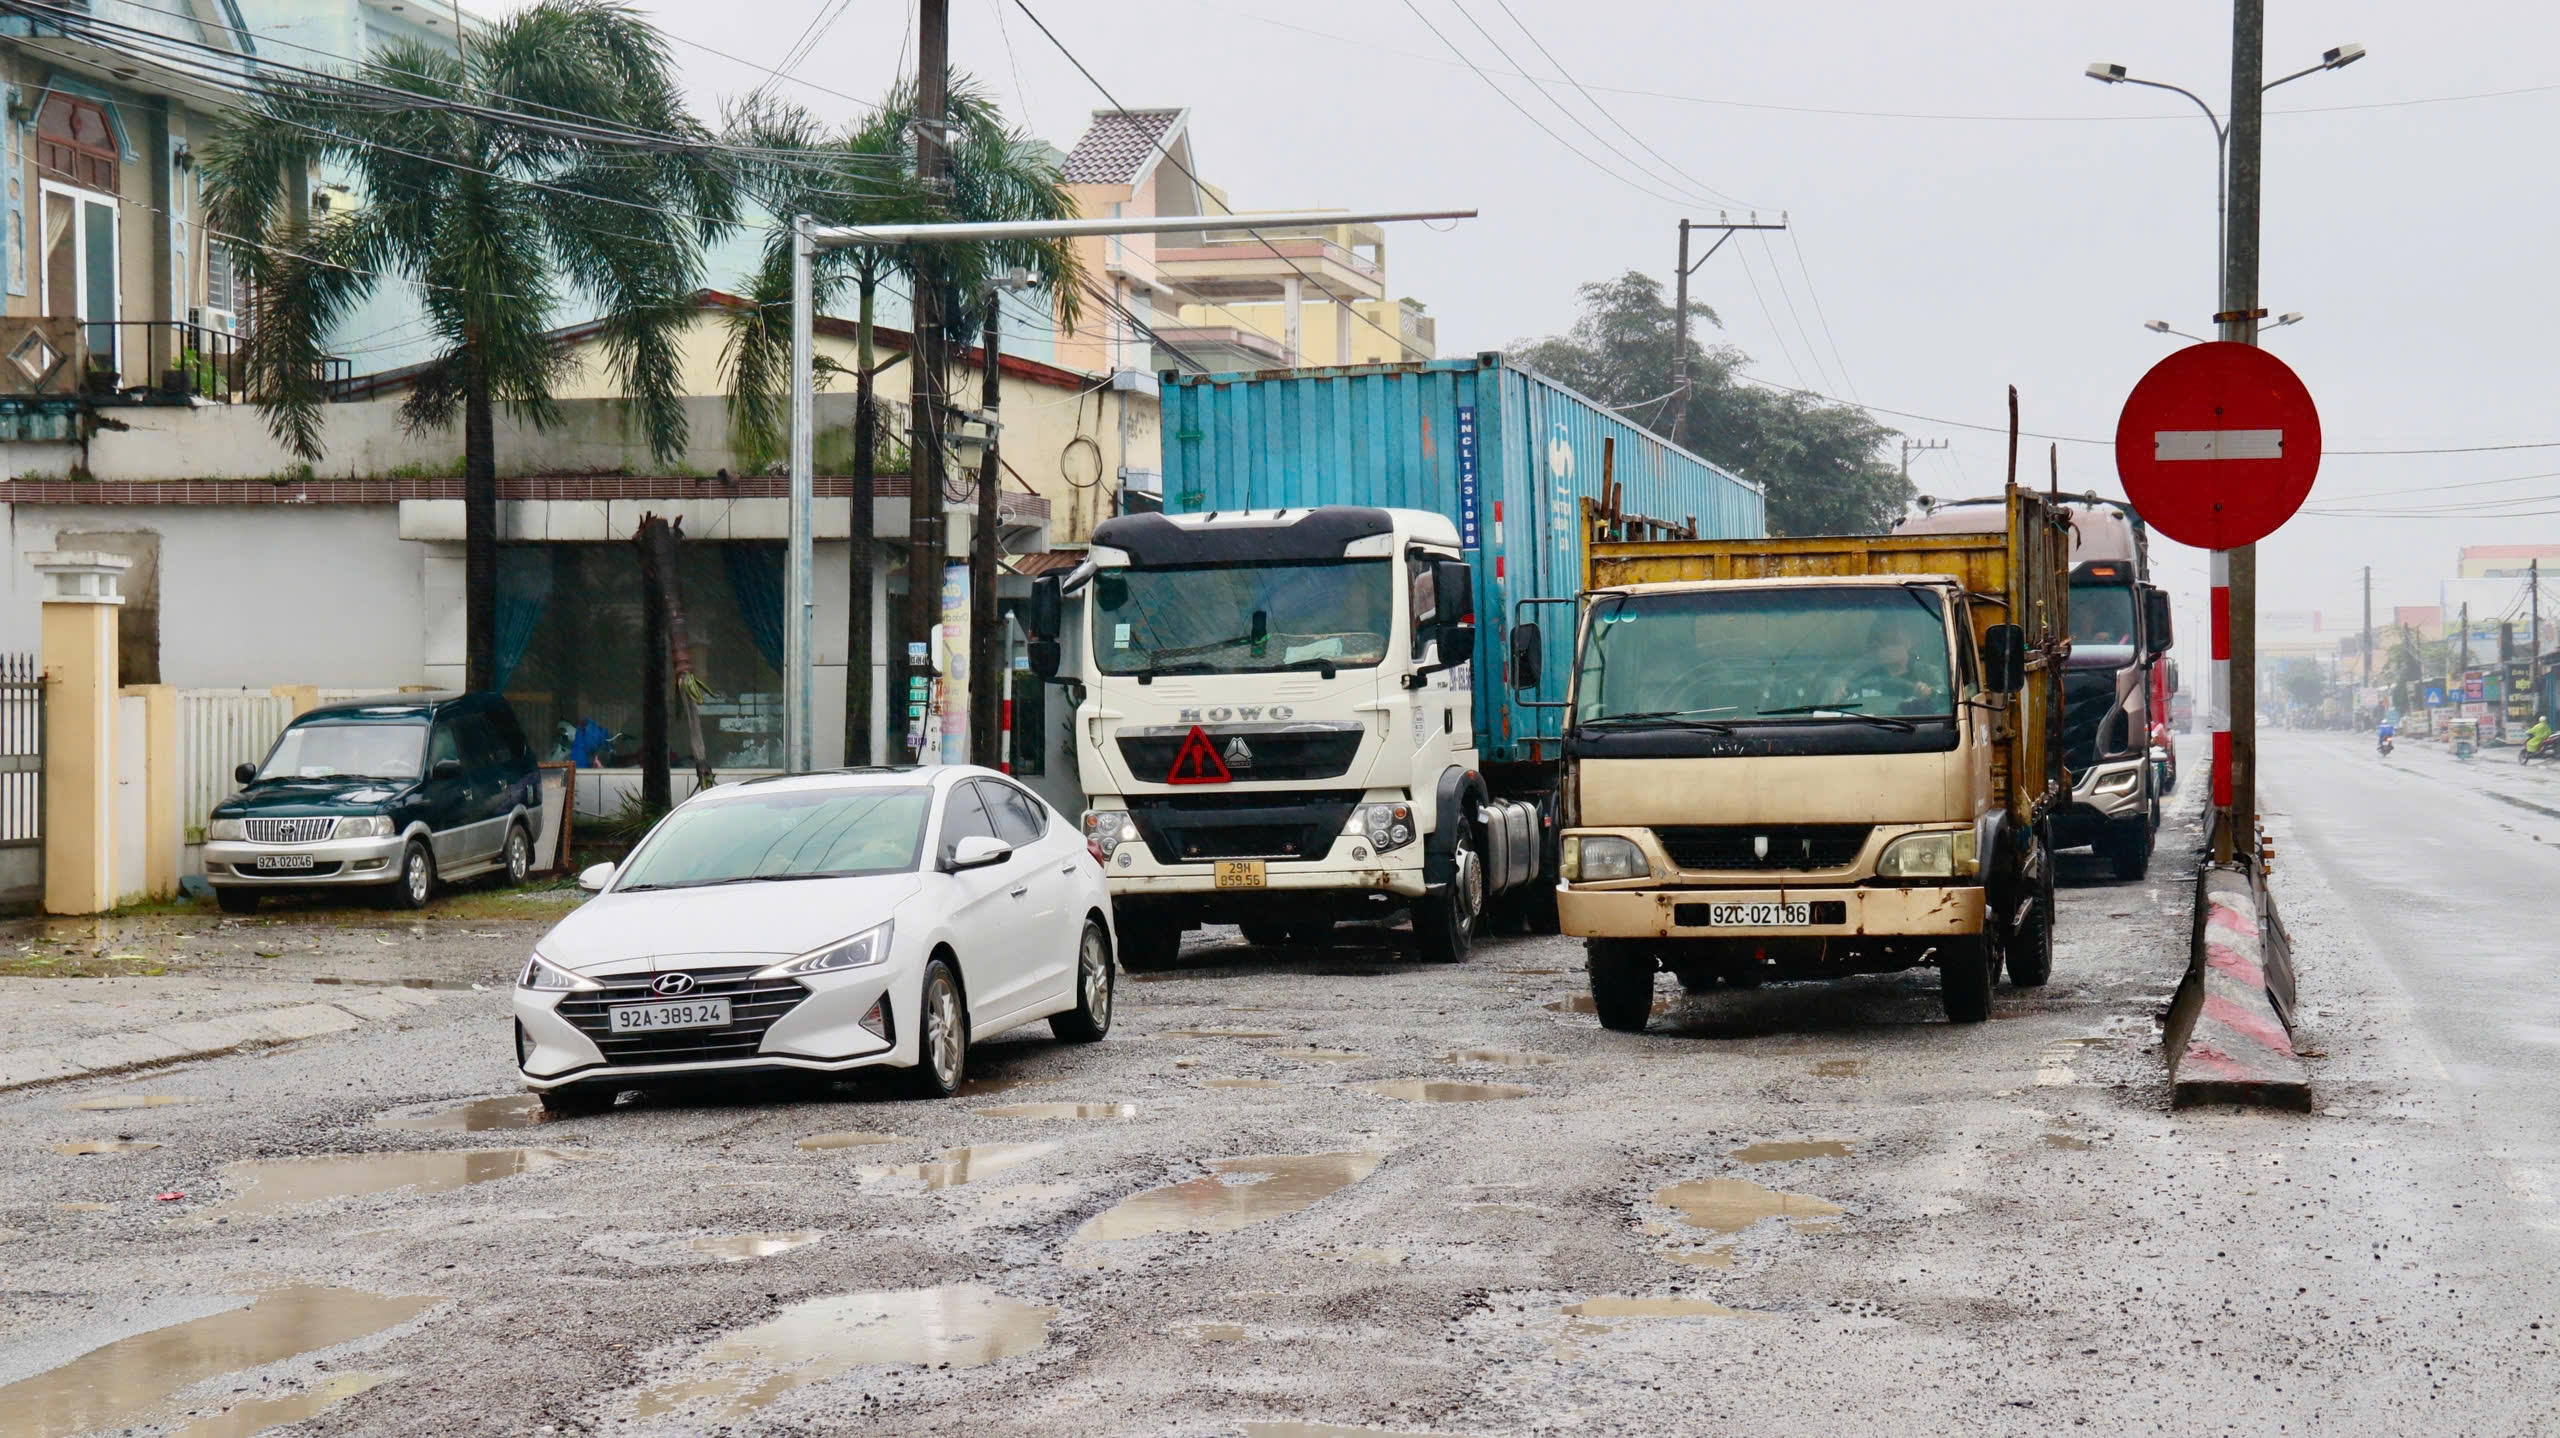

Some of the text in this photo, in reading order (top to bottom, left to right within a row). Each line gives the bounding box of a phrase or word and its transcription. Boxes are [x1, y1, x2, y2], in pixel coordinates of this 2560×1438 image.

[1461, 412, 1475, 544] HNCL1231988
[1178, 705, 1294, 722] HOWO
[1229, 862, 1251, 874] 29H
[1220, 874, 1260, 886] 859.56
[1713, 905, 1807, 924] 92C-021.86
[620, 1004, 721, 1028] 92A-389.24
